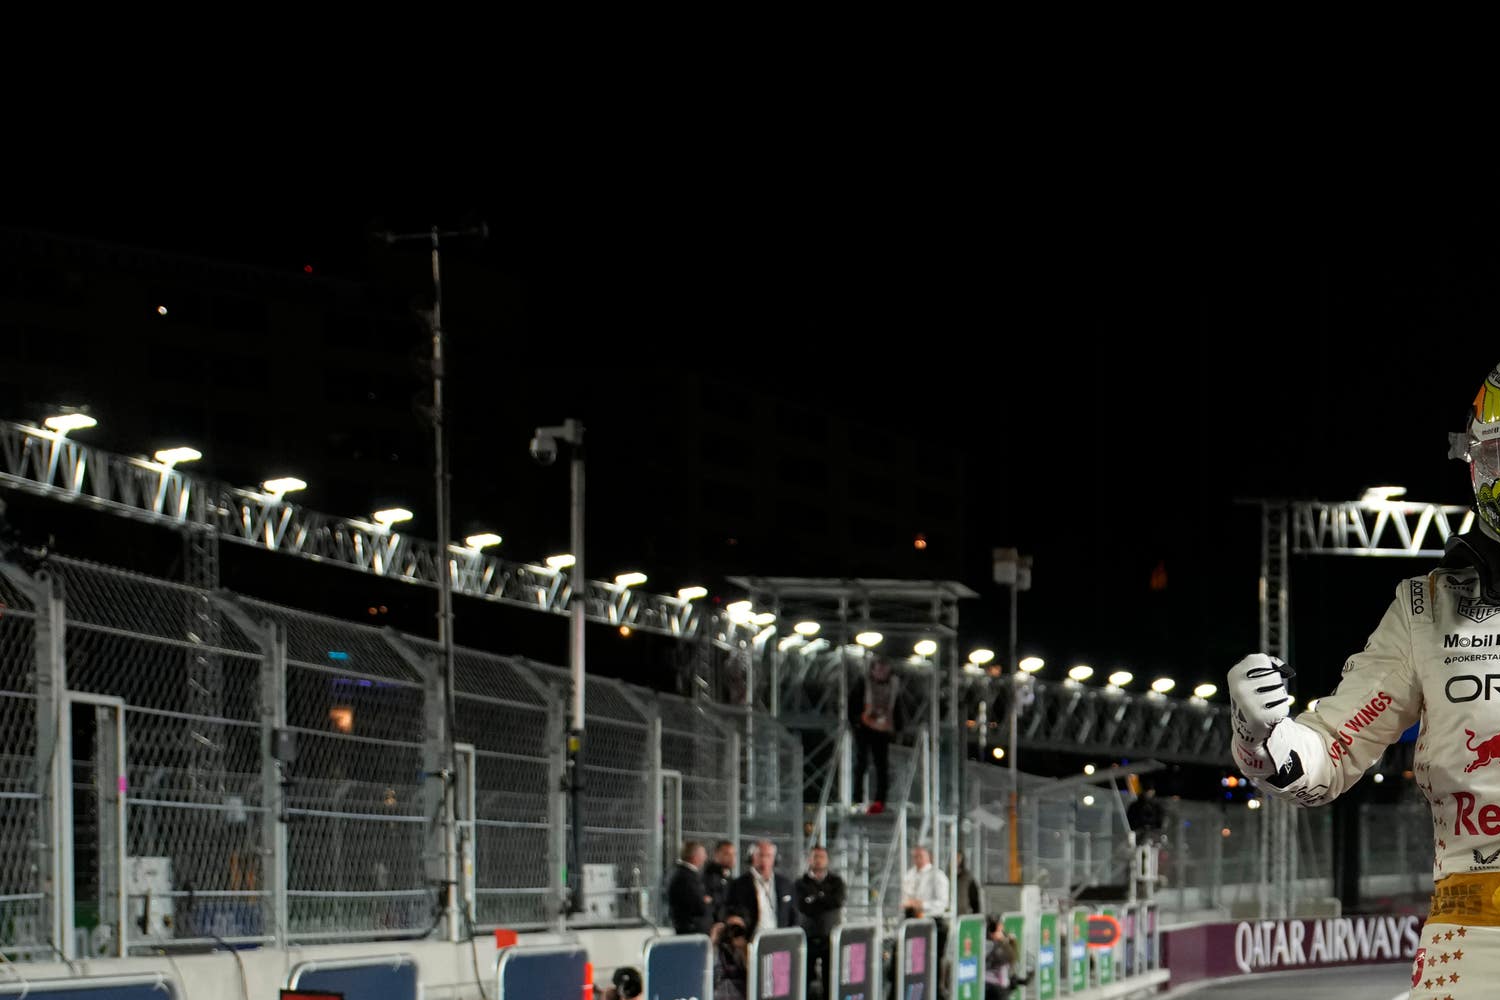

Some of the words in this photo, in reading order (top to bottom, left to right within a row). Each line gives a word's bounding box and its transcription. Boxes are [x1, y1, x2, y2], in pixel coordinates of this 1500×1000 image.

[1411, 580, 1425, 615] parco
[1444, 634, 1493, 649] Mobil
[1344, 691, 1393, 732] WINGS
[1235, 920, 1306, 975] QATAR
[1310, 915, 1420, 965] AIRWAYS
